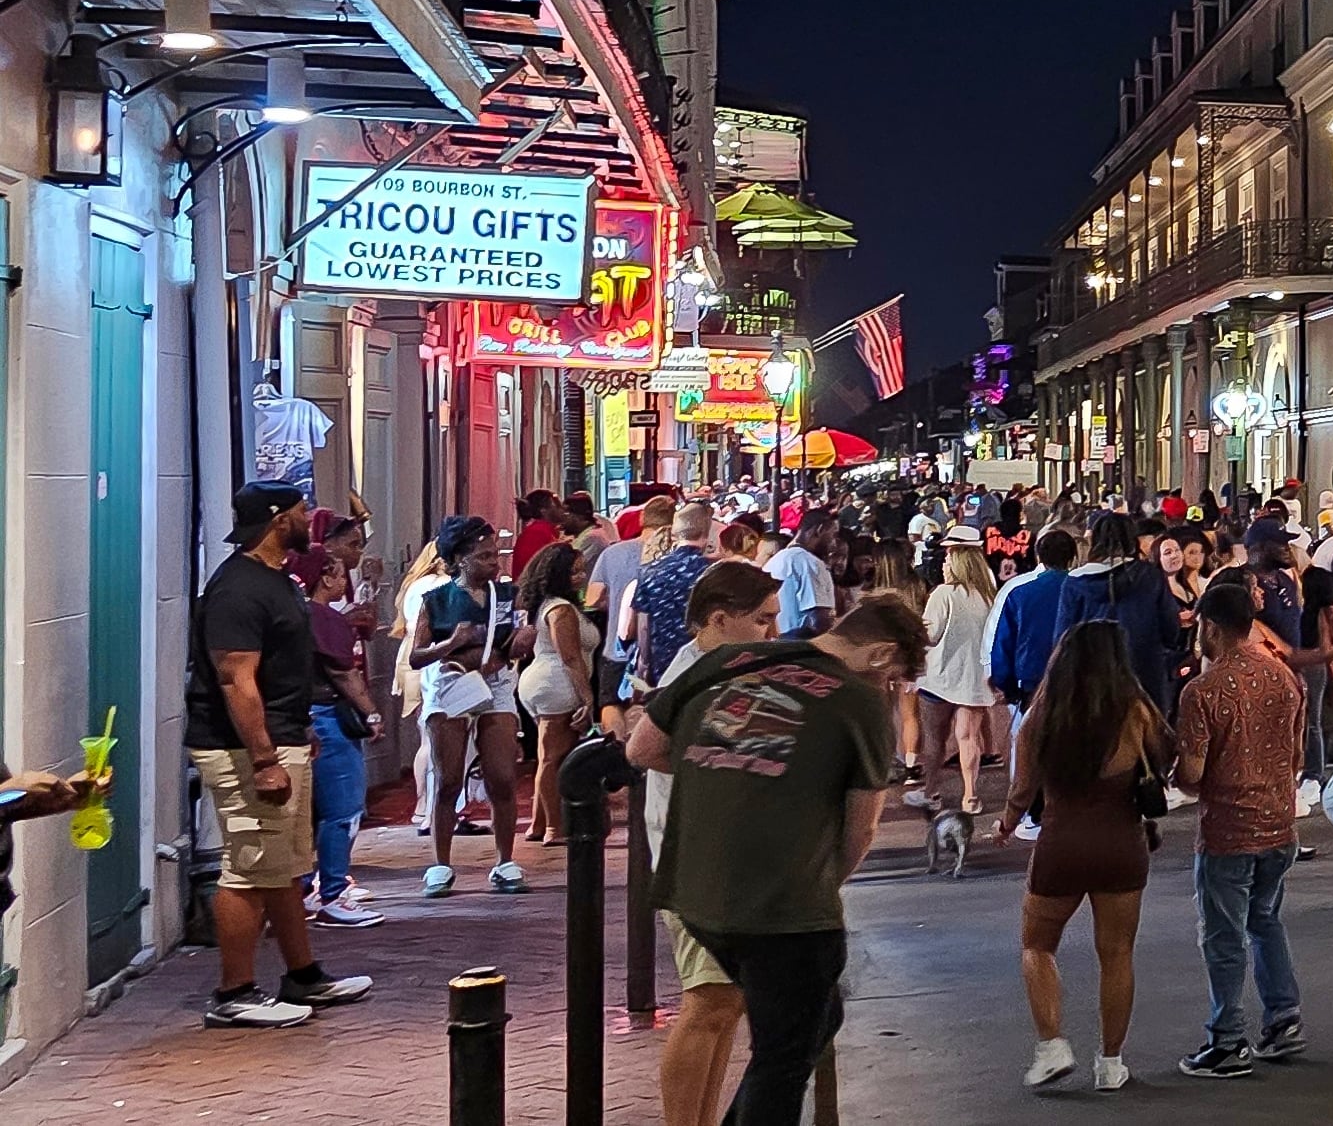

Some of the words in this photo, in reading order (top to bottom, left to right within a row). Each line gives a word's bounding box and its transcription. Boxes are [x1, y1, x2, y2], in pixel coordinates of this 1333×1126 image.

[412, 179, 494, 198] BOURBON
[317, 199, 455, 235] TRICOU
[473, 209, 577, 243] GIFTS
[349, 242, 543, 268] GUARANTEED
[327, 261, 446, 283] LOWEST
[458, 268, 561, 290] PRICES
